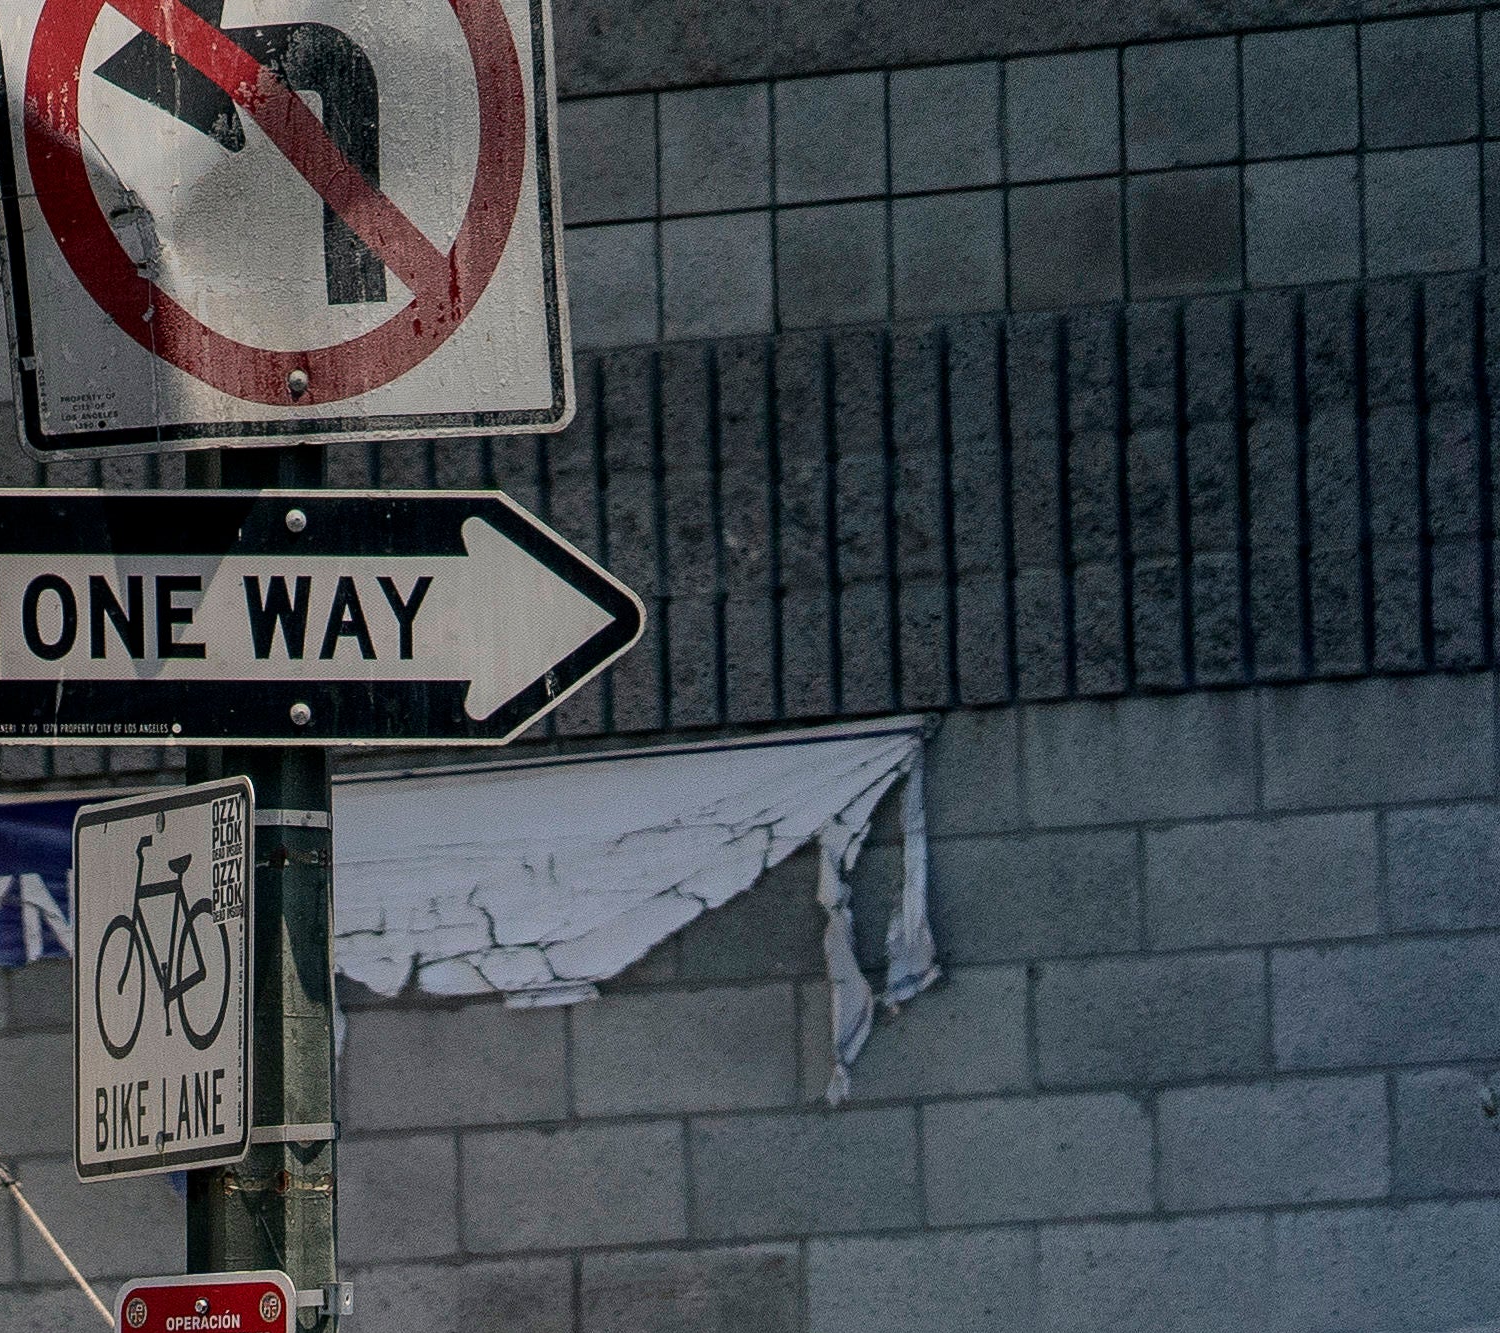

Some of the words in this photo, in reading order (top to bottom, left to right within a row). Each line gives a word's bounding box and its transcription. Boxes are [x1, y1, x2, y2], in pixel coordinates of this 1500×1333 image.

[61, 394, 101, 402] PROPERTY
[72, 404, 90, 412] CITY
[95, 402, 106, 410] OF
[82, 410, 118, 420] ANGELES
[22, 574, 206, 660] ONE
[243, 576, 434, 660] WAY
[60, 724, 94, 733] PROPERTY
[96, 724, 111, 733] CITY
[114, 724, 122, 733] OF
[124, 724, 136, 733] LOS
[139, 724, 168, 733] ANGELES
[212, 796, 241, 826] OZZY
[212, 820, 242, 850] PLOK
[212, 857, 242, 888] OZZY
[212, 882, 242, 910] PLOK
[96, 1080, 149, 1152] BIKE
[162, 1068, 224, 1142] LANE
[166, 1310, 240, 1331] OPERACIÓN
